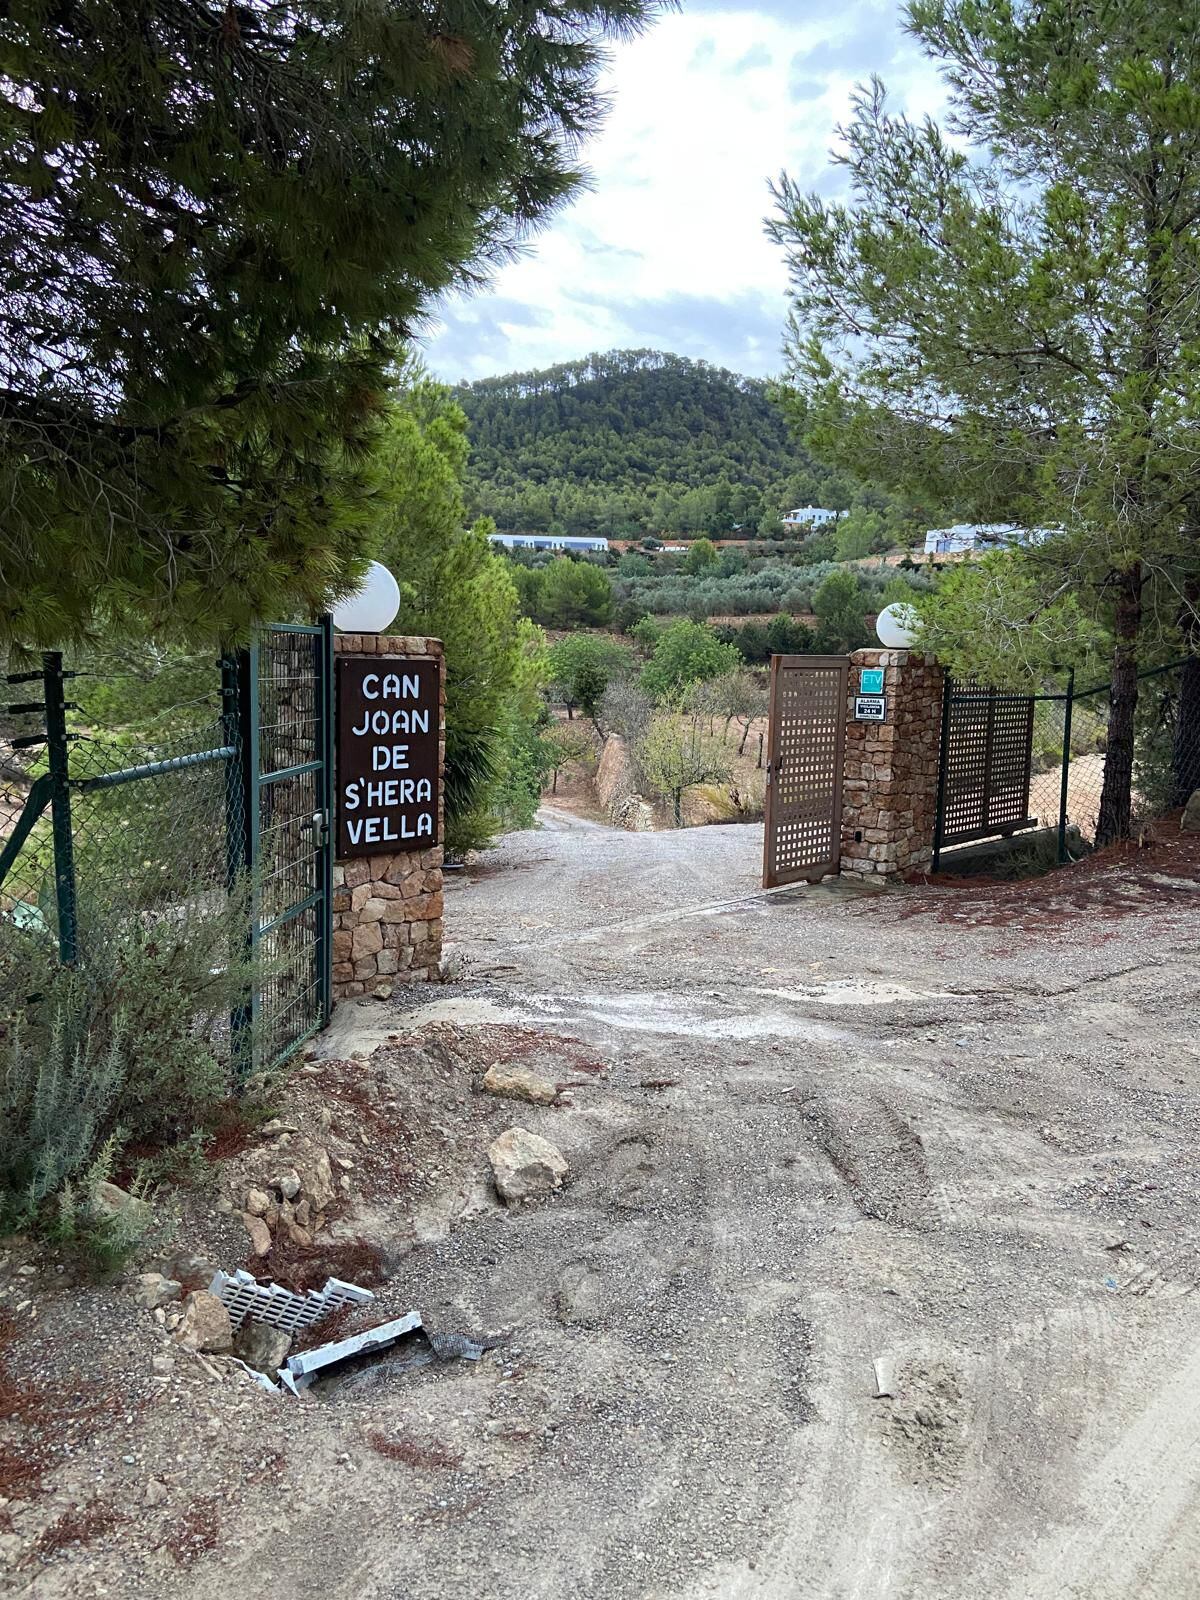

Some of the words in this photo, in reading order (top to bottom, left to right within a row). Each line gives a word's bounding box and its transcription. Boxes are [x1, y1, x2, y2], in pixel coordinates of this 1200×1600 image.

[362, 673, 420, 700] CAN
[863, 674, 881, 684] ETV
[352, 709, 429, 736] JOAN
[372, 744, 409, 771] DE
[345, 776, 431, 810] S'HERA
[347, 812, 432, 845] VELLA
